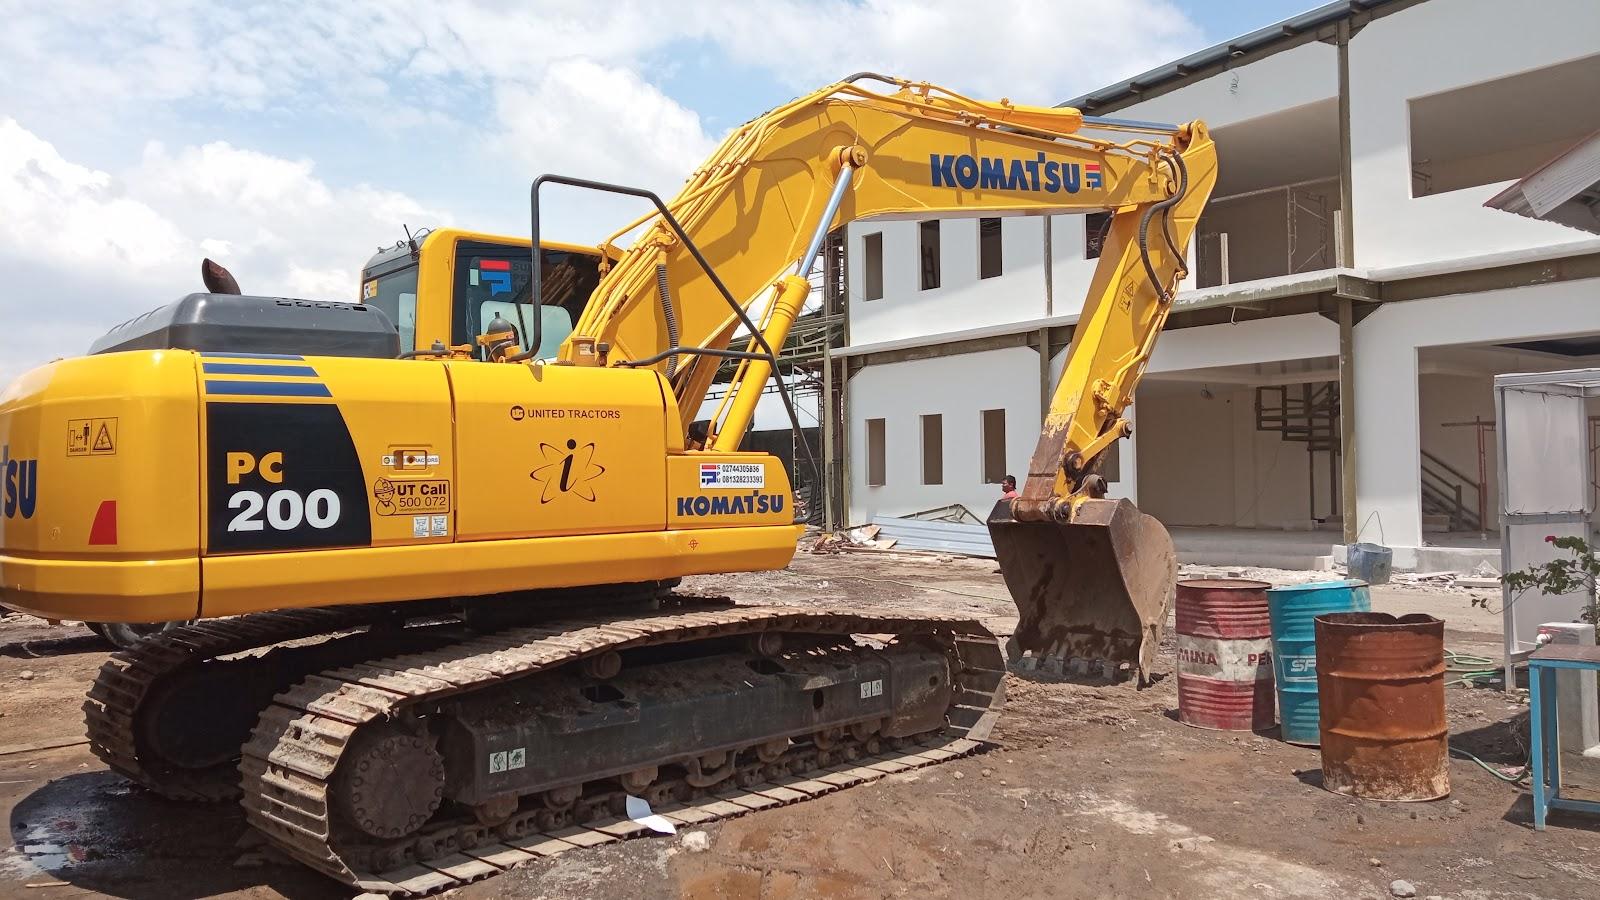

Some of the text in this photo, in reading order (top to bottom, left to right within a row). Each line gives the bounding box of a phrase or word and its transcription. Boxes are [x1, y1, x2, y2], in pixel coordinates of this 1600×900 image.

[930, 152, 1081, 194] KOMATSU
[527, 409, 565, 418] UNITED
[568, 409, 621, 419] TRACTORS
[226, 452, 283, 484] PC
[397, 484, 447, 496] UT Call
[399, 496, 446, 507] 500 072
[677, 490, 784, 516] KOMATSU
[227, 488, 341, 532] 200
